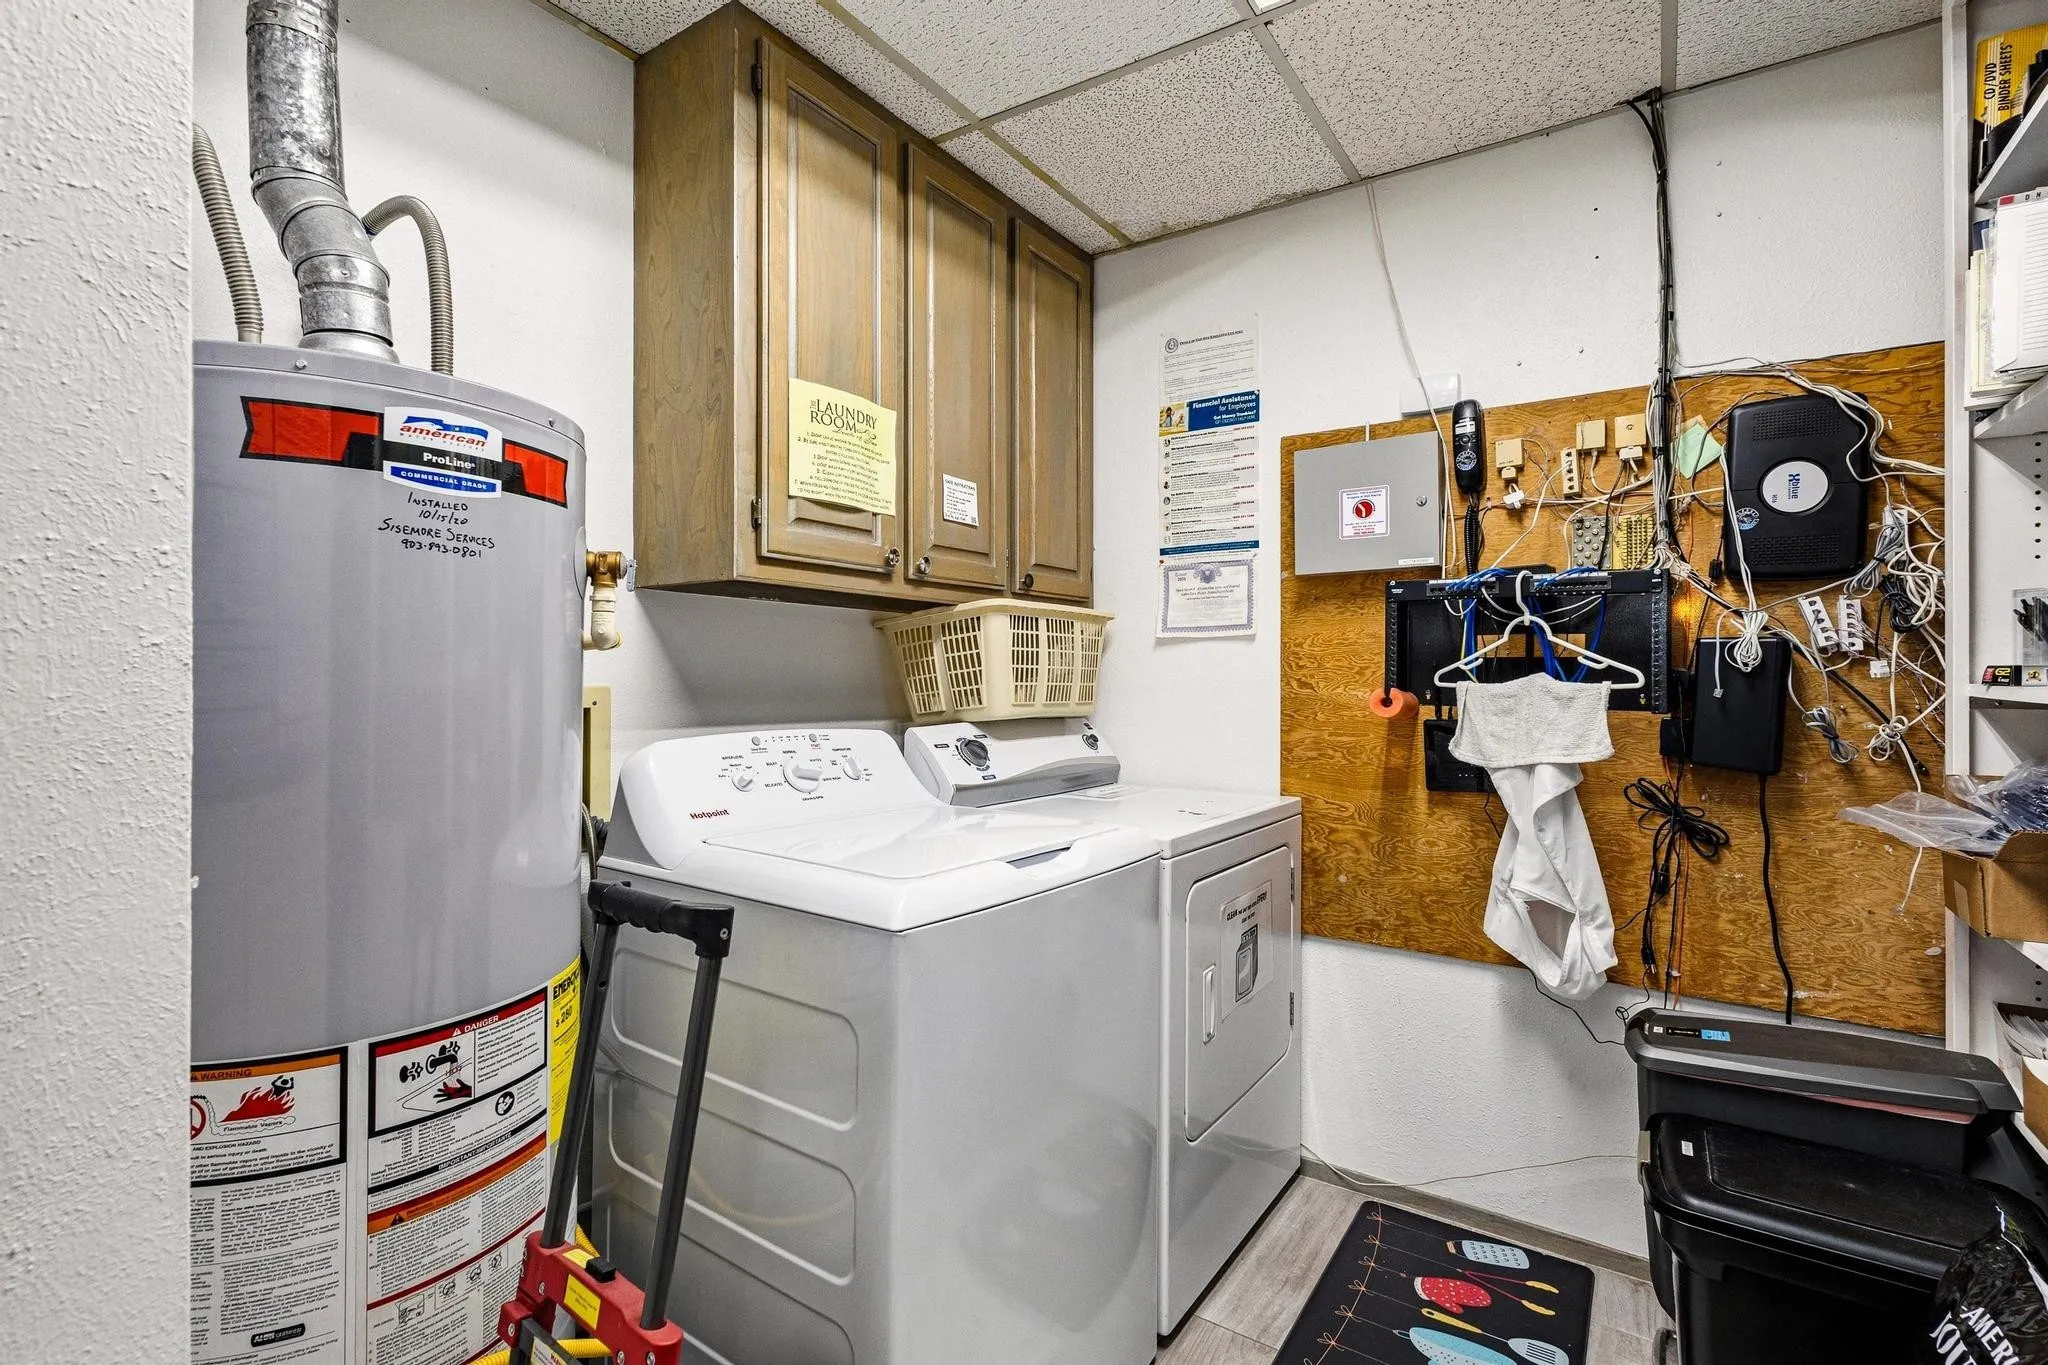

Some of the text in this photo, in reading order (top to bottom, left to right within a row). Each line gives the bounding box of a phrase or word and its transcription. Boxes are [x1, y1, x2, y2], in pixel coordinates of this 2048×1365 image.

[1984, 62, 1997, 100] CD/DVD
[1998, 44, 2013, 111] BINDER SHEETS
[810, 410, 857, 433] ROOM
[817, 398, 878, 430] LAUNDRY
[400, 424, 486, 447] american
[400, 471, 488, 490] COMMERCIAL GRADE
[1788, 473, 1800, 499] Xblue
[446, 528, 495, 549] SERVICES
[1995, 668, 2011, 676] G2
[690, 808, 730, 820] Hotpoint
[464, 1015, 500, 1033] DANGER
[200, 1069, 252, 1081] WARNING
